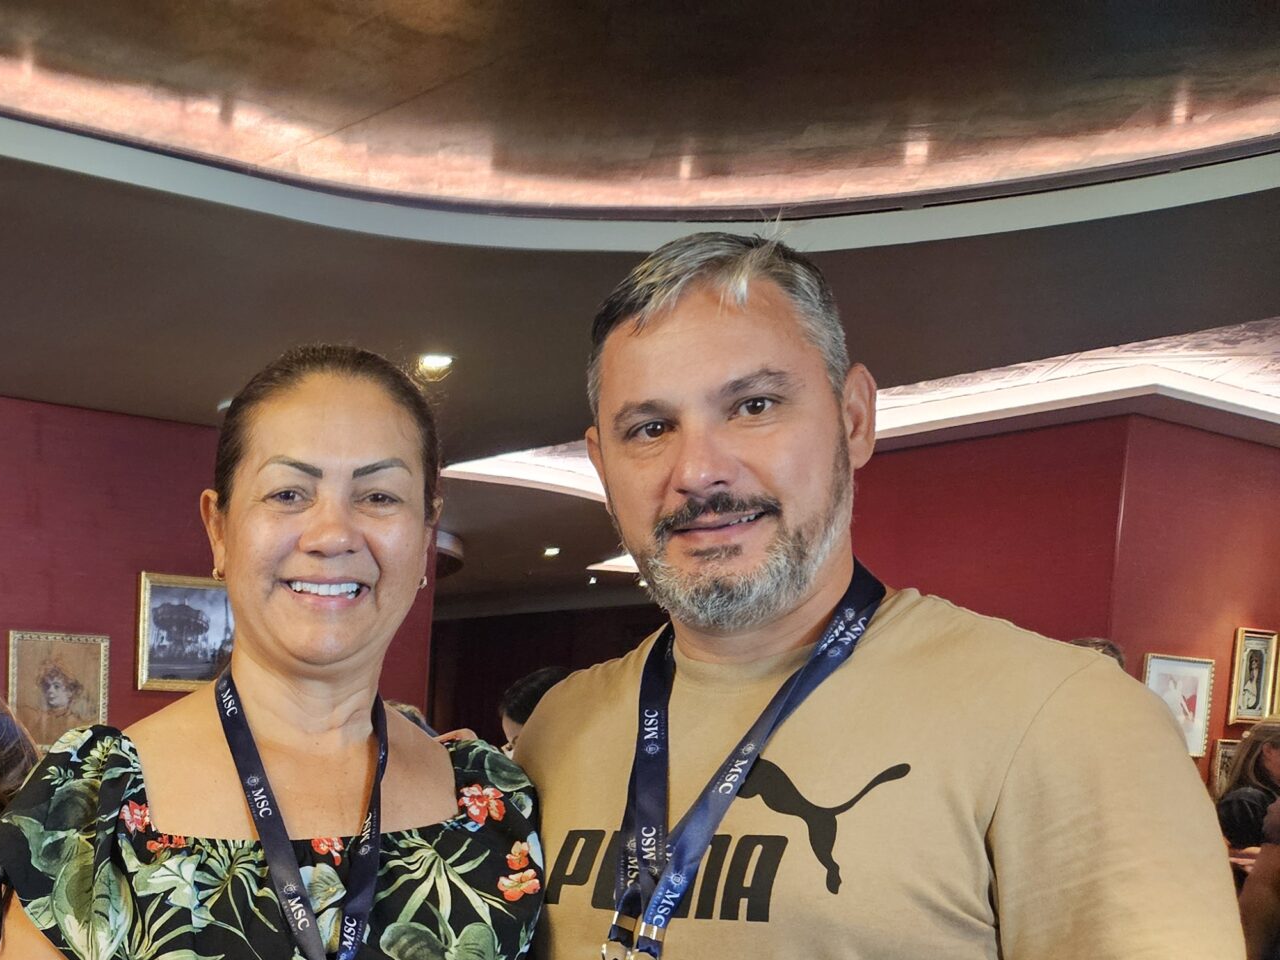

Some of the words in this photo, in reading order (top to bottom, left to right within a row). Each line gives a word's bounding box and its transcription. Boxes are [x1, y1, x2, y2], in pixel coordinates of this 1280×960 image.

[221, 688, 238, 717] MSC
[644, 709, 659, 740] MSC
[718, 758, 749, 795] MSC
[252, 787, 272, 818] MSC
[641, 826, 657, 861] MSC
[288, 896, 310, 931] MSC
[653, 889, 680, 928] MSC
[342, 916, 357, 951] MSC
